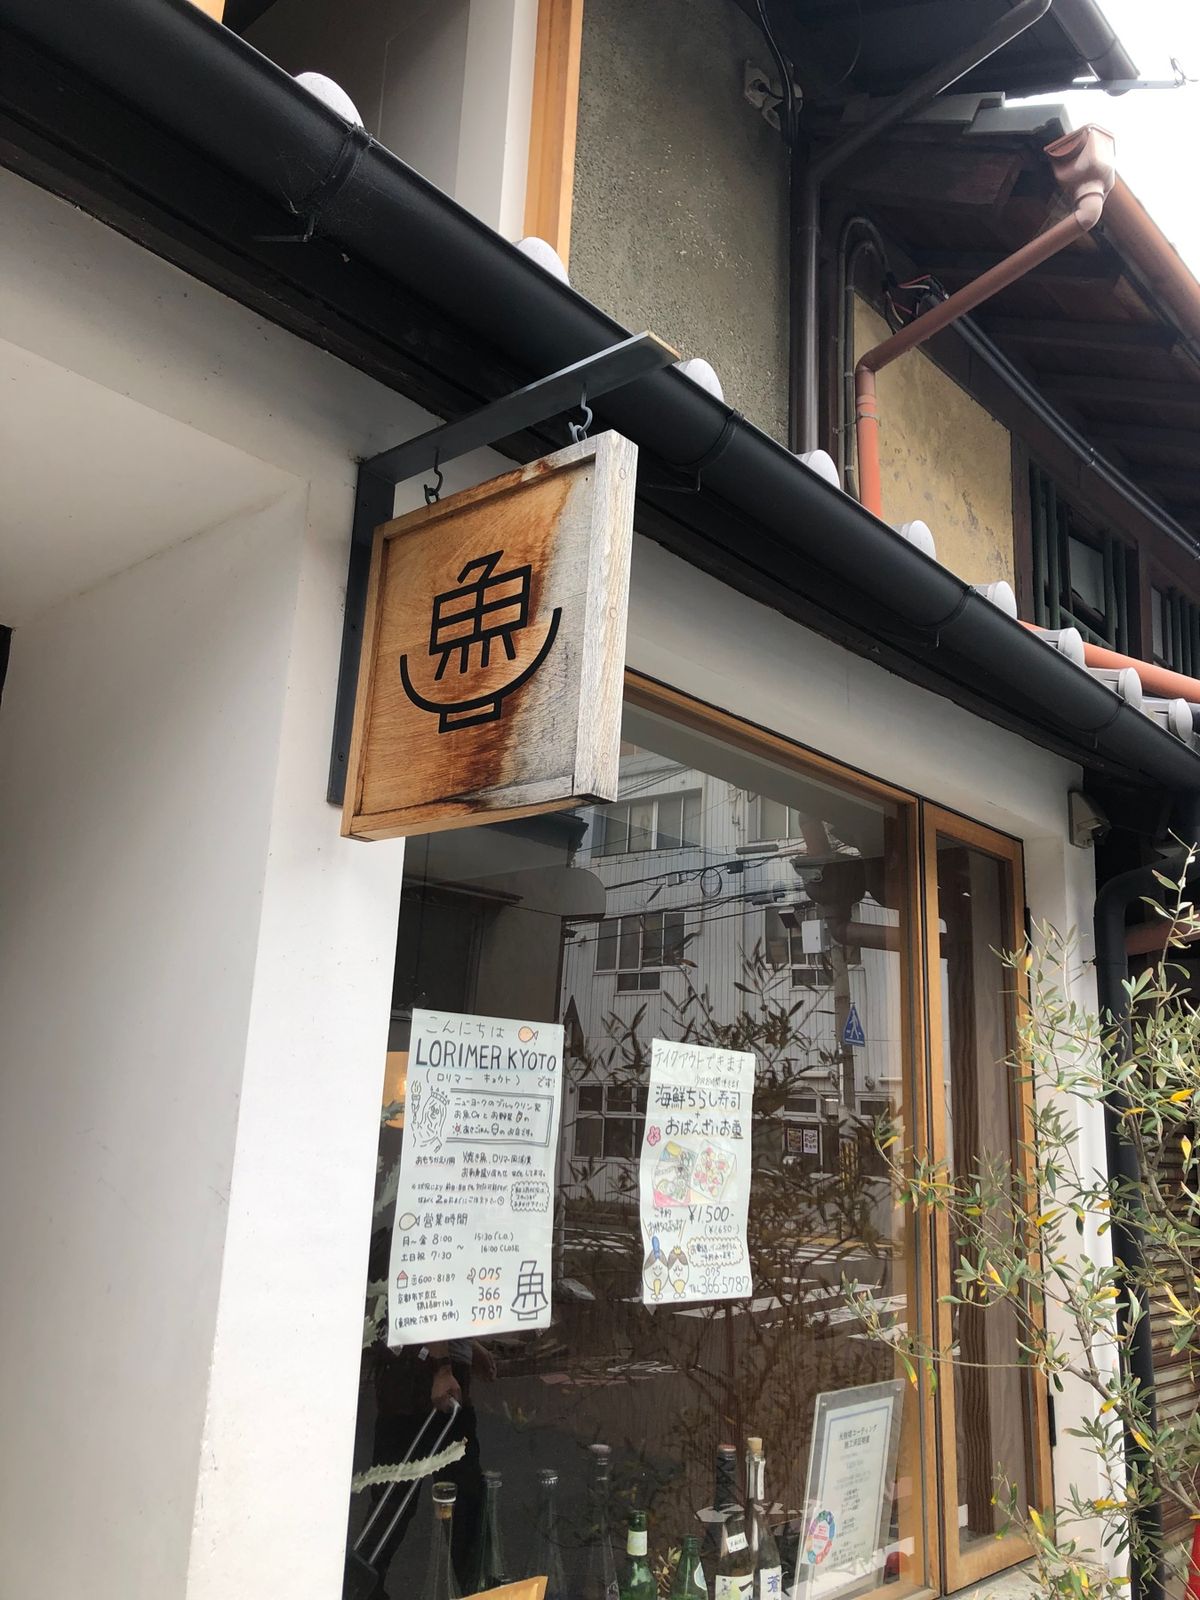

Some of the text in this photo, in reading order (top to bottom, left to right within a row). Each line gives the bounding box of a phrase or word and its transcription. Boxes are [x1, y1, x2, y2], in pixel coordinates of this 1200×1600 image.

[426, 1015, 505, 1039] こんにちは
[415, 1038, 557, 1072] LORIMER KYOTO
[654, 1047, 746, 1074] テイクアウトできます
[655, 1084, 741, 1110] 海鮮ちらし寿司
[665, 1116, 743, 1139] おばんざいお重
[423, 1212, 469, 1228] 営業時間
[432, 1233, 453, 1246] 8:00
[474, 1232, 492, 1241] 15:30
[430, 1250, 453, 1261] 7:30
[479, 1267, 503, 1281] 075
[705, 1267, 721, 1277] 075
[478, 1286, 501, 1301] 366
[471, 1304, 503, 1321] 5787
